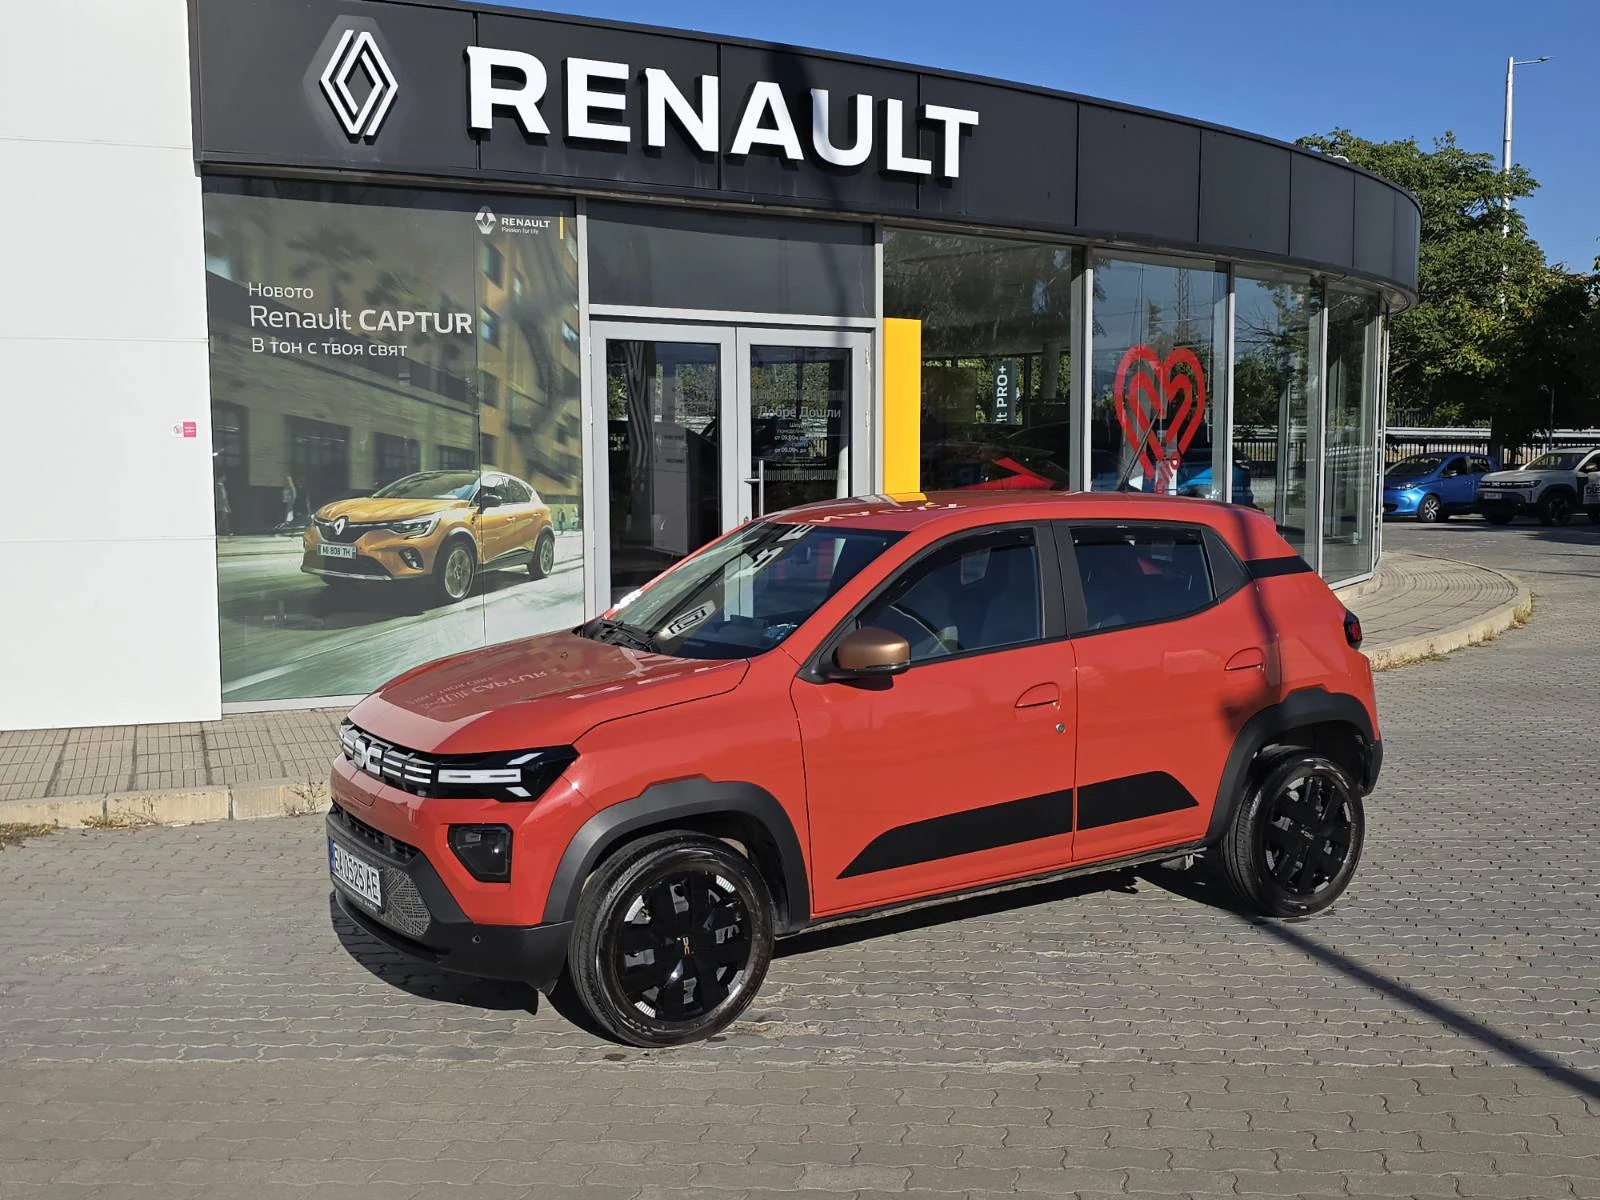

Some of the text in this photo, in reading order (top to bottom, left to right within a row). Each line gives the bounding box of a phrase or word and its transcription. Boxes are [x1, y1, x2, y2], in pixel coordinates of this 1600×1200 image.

[465, 45, 980, 179] RENAULT
[501, 217, 551, 229] RENAULT
[248, 281, 314, 299] Новото
[249, 305, 473, 334] Renault CAPTUR
[251, 337, 408, 357] В тон с твоя свят
[996, 365, 1008, 408] PRO+
